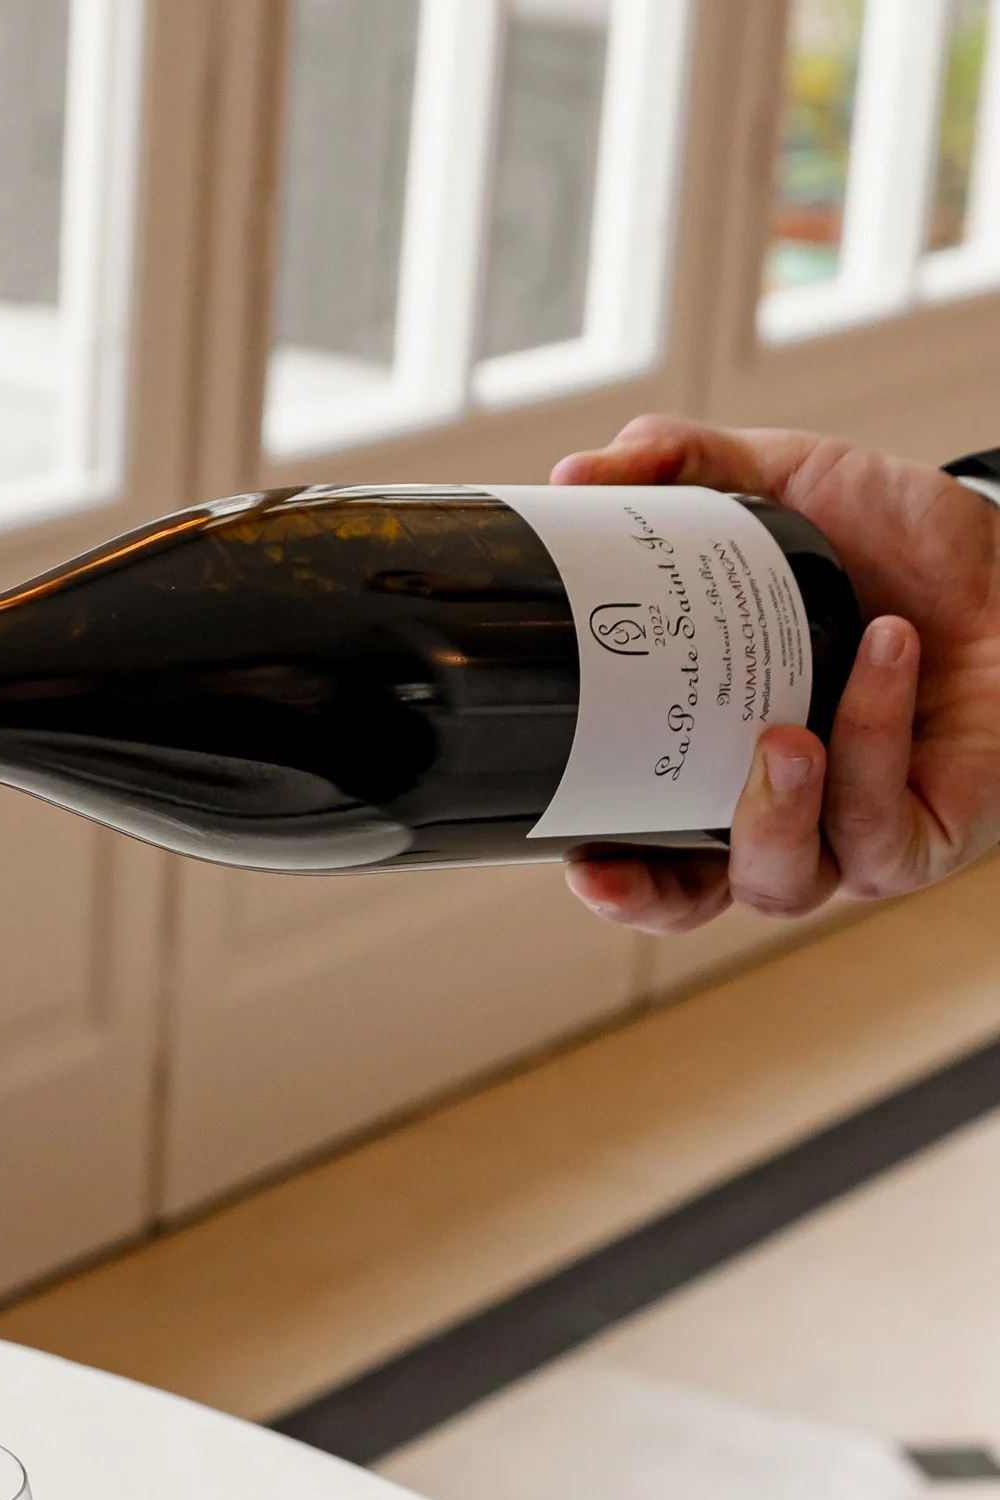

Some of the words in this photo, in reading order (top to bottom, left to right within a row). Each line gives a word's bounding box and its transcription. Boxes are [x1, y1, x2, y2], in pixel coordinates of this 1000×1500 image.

[623, 506, 675, 555] Jean
[649, 604, 666, 647] 2022
[657, 557, 696, 640] Saint
[711, 539, 758, 722] SAUMUR-CHAMPIGNY
[667, 644, 700, 732] Porte
[759, 668, 772, 722] Appellation
[654, 735, 691, 782] La
